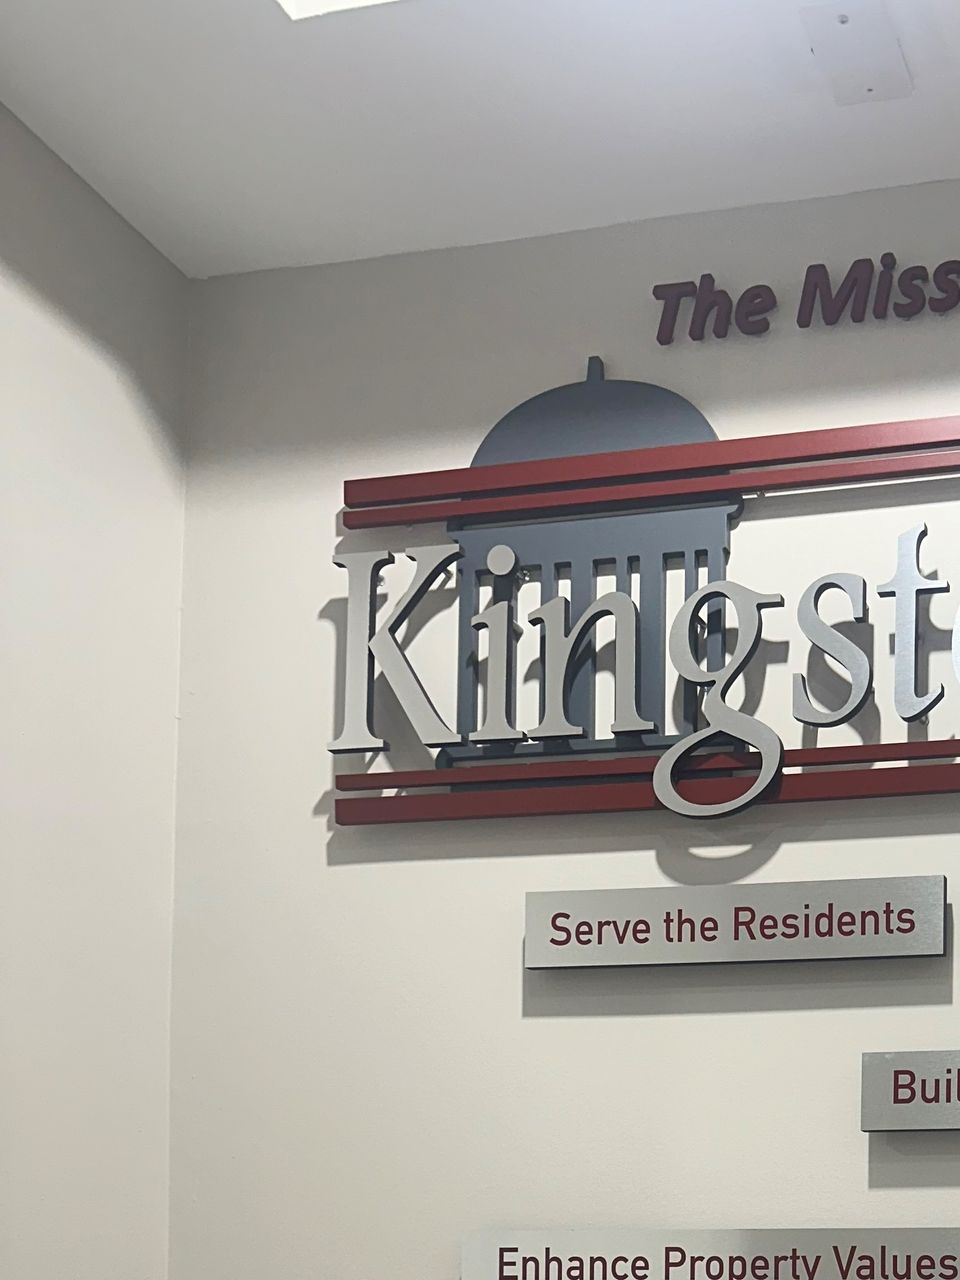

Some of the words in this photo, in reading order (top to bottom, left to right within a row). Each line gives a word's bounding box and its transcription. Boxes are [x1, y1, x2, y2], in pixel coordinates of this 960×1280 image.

[652, 273, 778, 346] The
[549, 912, 651, 946] Serve
[663, 908, 719, 943] the
[733, 902, 916, 941] Residents
[498, 1247, 650, 1280] Enhance
[832, 1246, 959, 1280] Values
